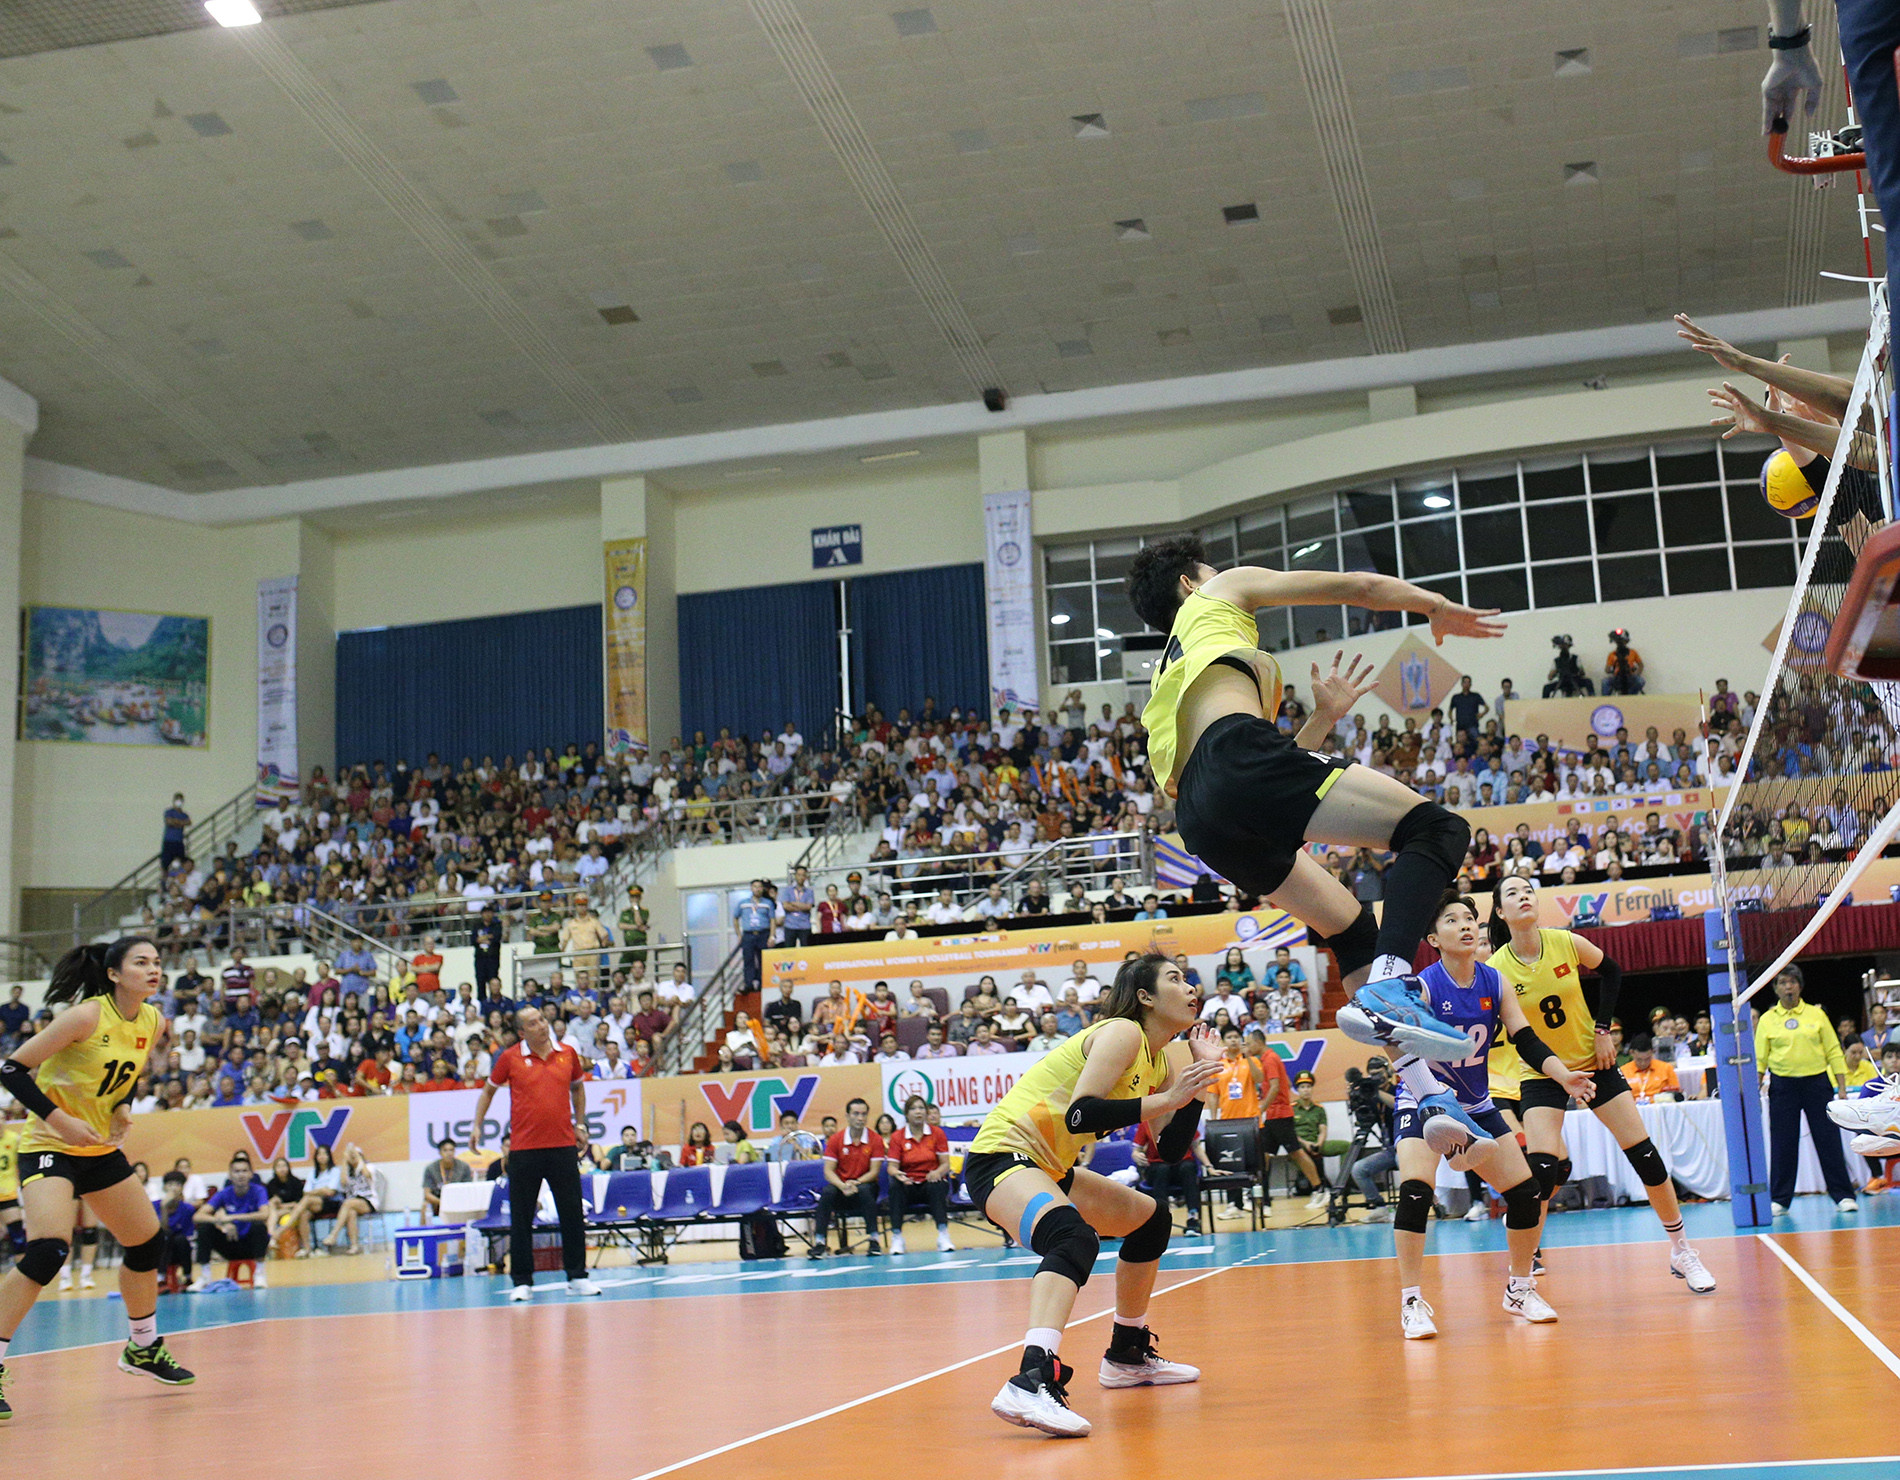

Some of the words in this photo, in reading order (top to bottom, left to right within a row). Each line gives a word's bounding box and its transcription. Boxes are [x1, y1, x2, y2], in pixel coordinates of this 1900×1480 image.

[827, 548, 848, 565] A
[1555, 892, 1608, 917] VTV
[1615, 889, 1674, 915] Ferroli
[1677, 885, 1717, 908] CU
[1028, 942, 1052, 954] VTV
[1079, 941, 1098, 950] CUP
[773, 961, 795, 972] VTV
[1539, 994, 1567, 1029] 8
[97, 1059, 136, 1097] 16
[699, 1073, 820, 1132] VTV
[240, 1106, 353, 1163] VTV
[427, 1110, 606, 1150] USPS
[1399, 1113, 1412, 1130] 12
[38, 1153, 55, 1170] 16
